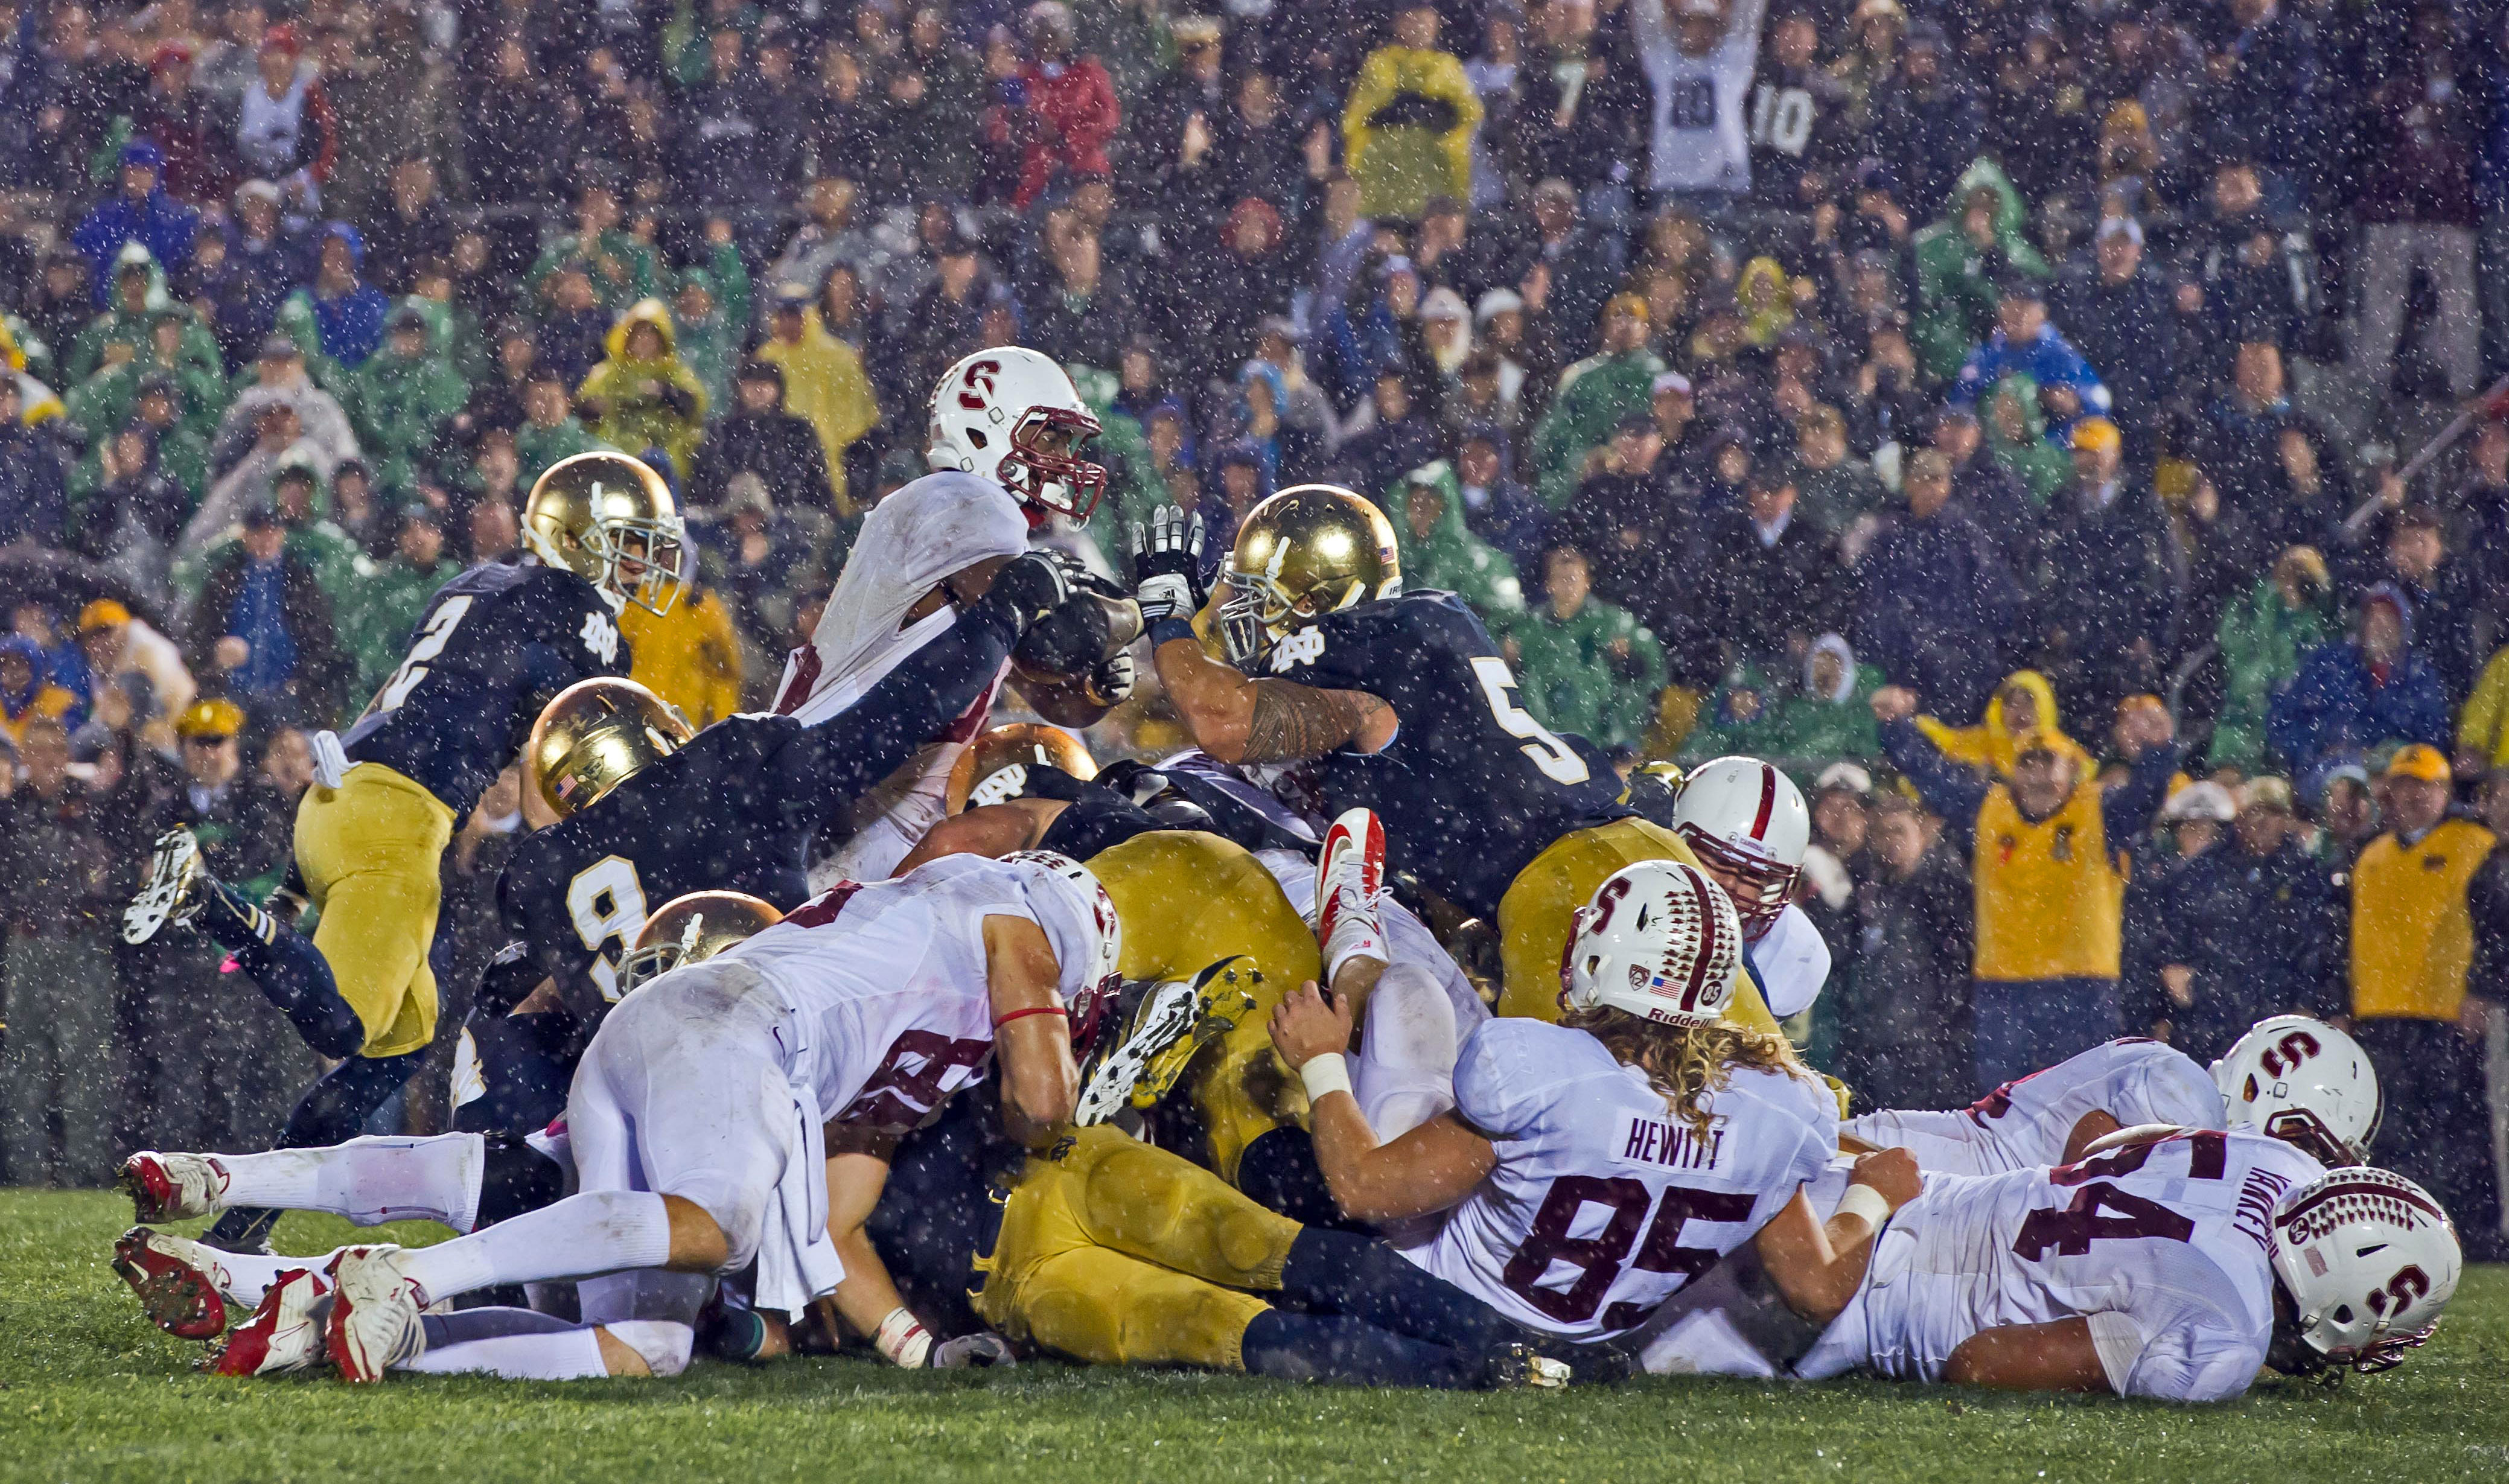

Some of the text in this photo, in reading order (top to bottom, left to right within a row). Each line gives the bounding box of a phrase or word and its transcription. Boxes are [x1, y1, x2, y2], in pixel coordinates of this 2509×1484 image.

[1552, 62, 1588, 121] 7
[1753, 83, 1812, 159] 10
[957, 360, 1001, 410] S
[381, 595, 473, 712] 2
[1469, 656, 1590, 786] 5
[566, 854, 649, 1004] 9
[1587, 876, 1632, 935] S
[1648, 1007, 1710, 1028] Riddell
[1702, 985, 1721, 1002] 85
[2260, 1031, 2321, 1079] S
[1624, 1118, 1724, 1170] HEWITT
[2232, 1167, 2292, 1251] YANKEY
[2290, 1218, 2309, 1243] 54
[1503, 1175, 1759, 1331] 85
[2365, 1264, 2430, 1319] S
